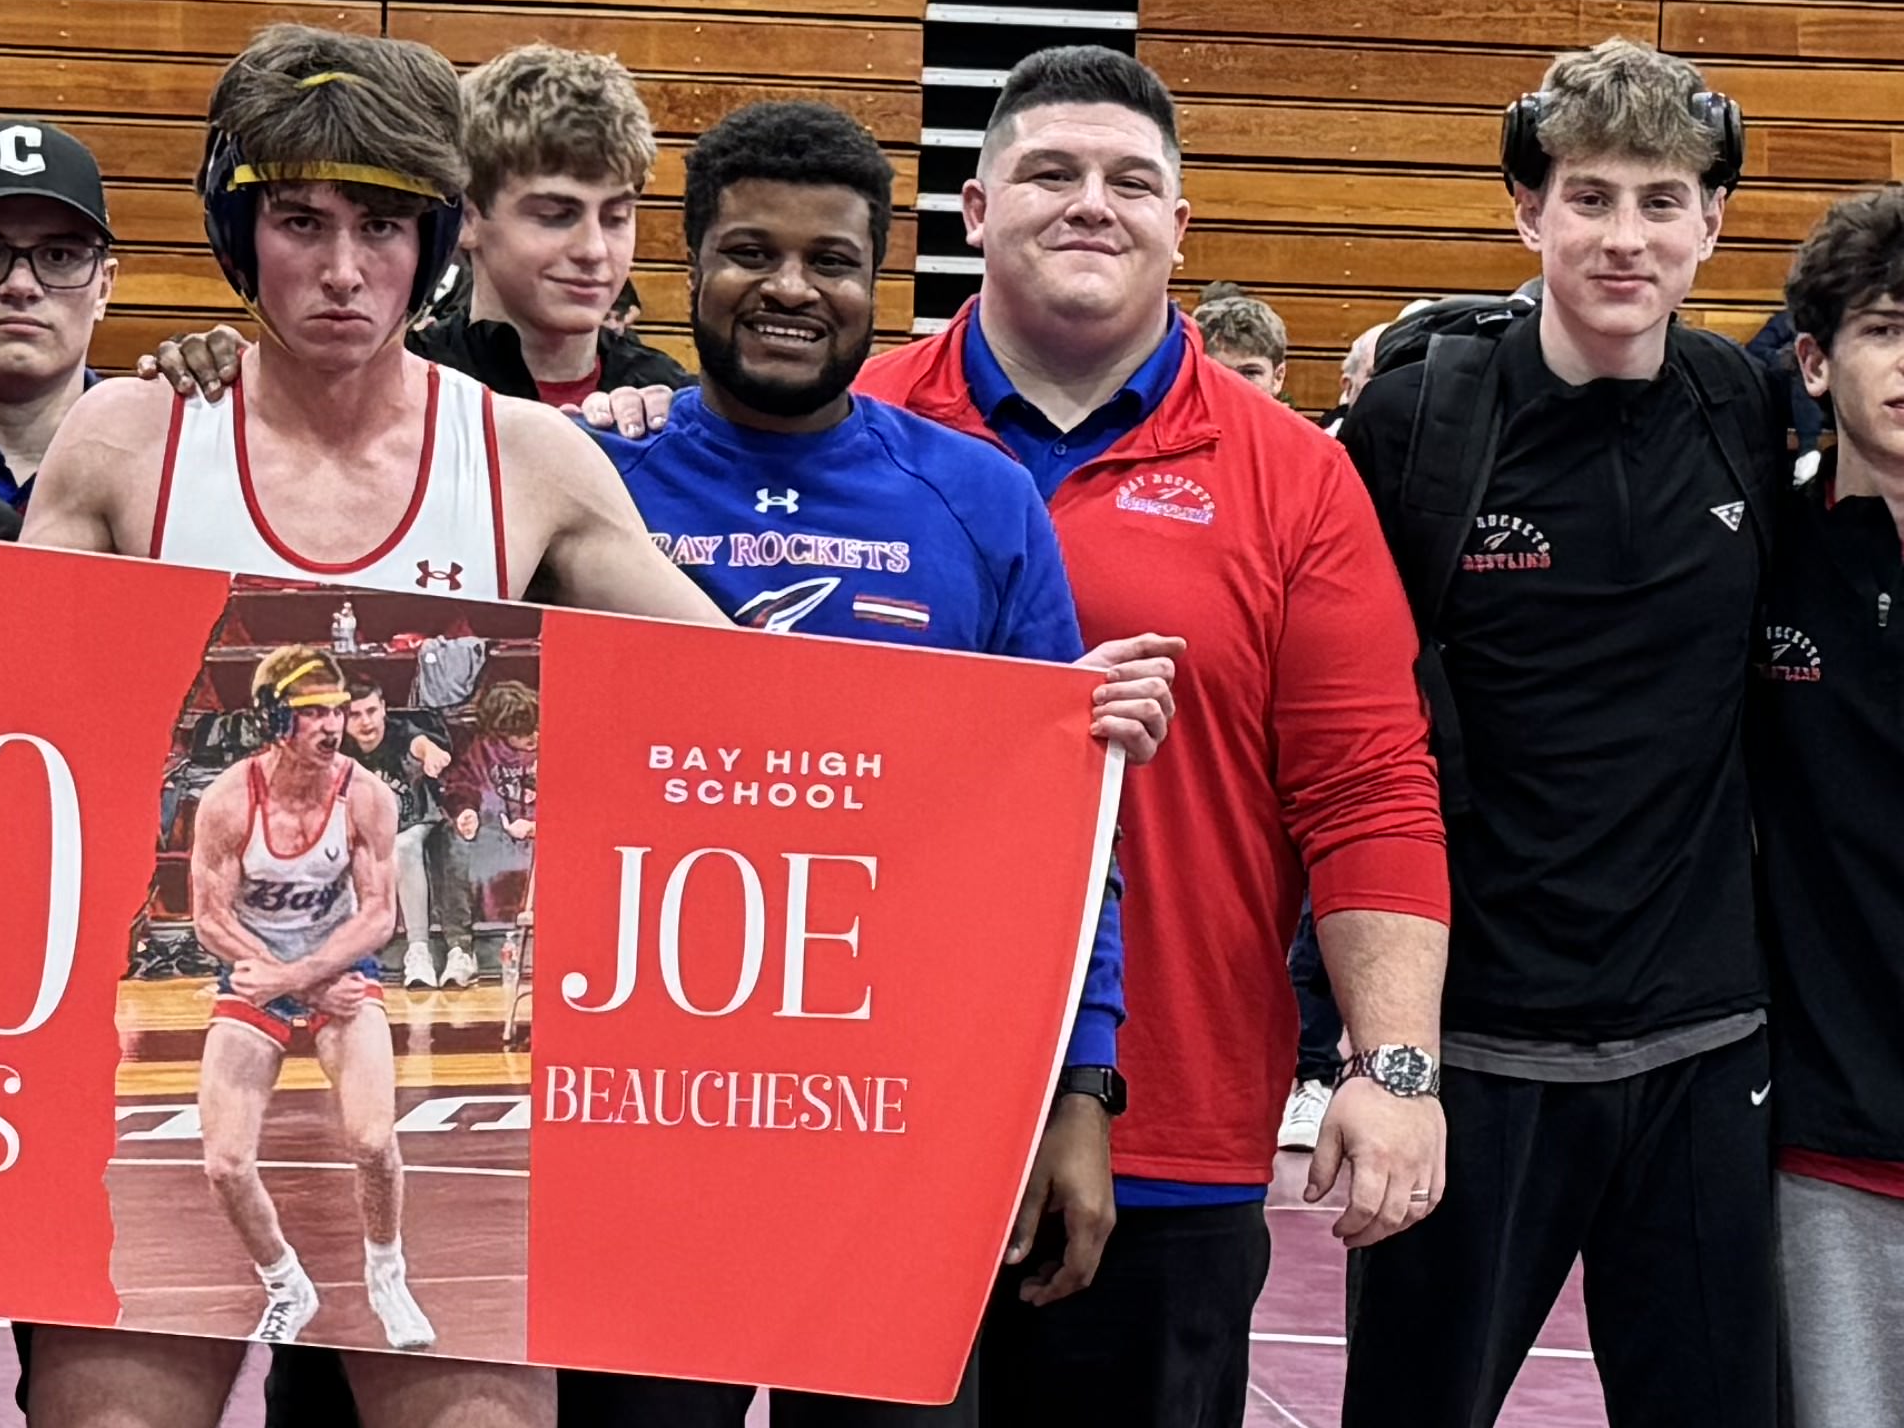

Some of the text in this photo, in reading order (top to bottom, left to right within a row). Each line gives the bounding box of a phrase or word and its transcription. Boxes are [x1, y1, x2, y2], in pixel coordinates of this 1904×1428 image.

[728, 530, 910, 573] ROCKETS
[649, 745, 881, 778] BAY HIGH
[664, 779, 864, 810] SCHOOL
[561, 845, 878, 1020] JOE
[543, 1066, 909, 1134] BEAUCHESNE
